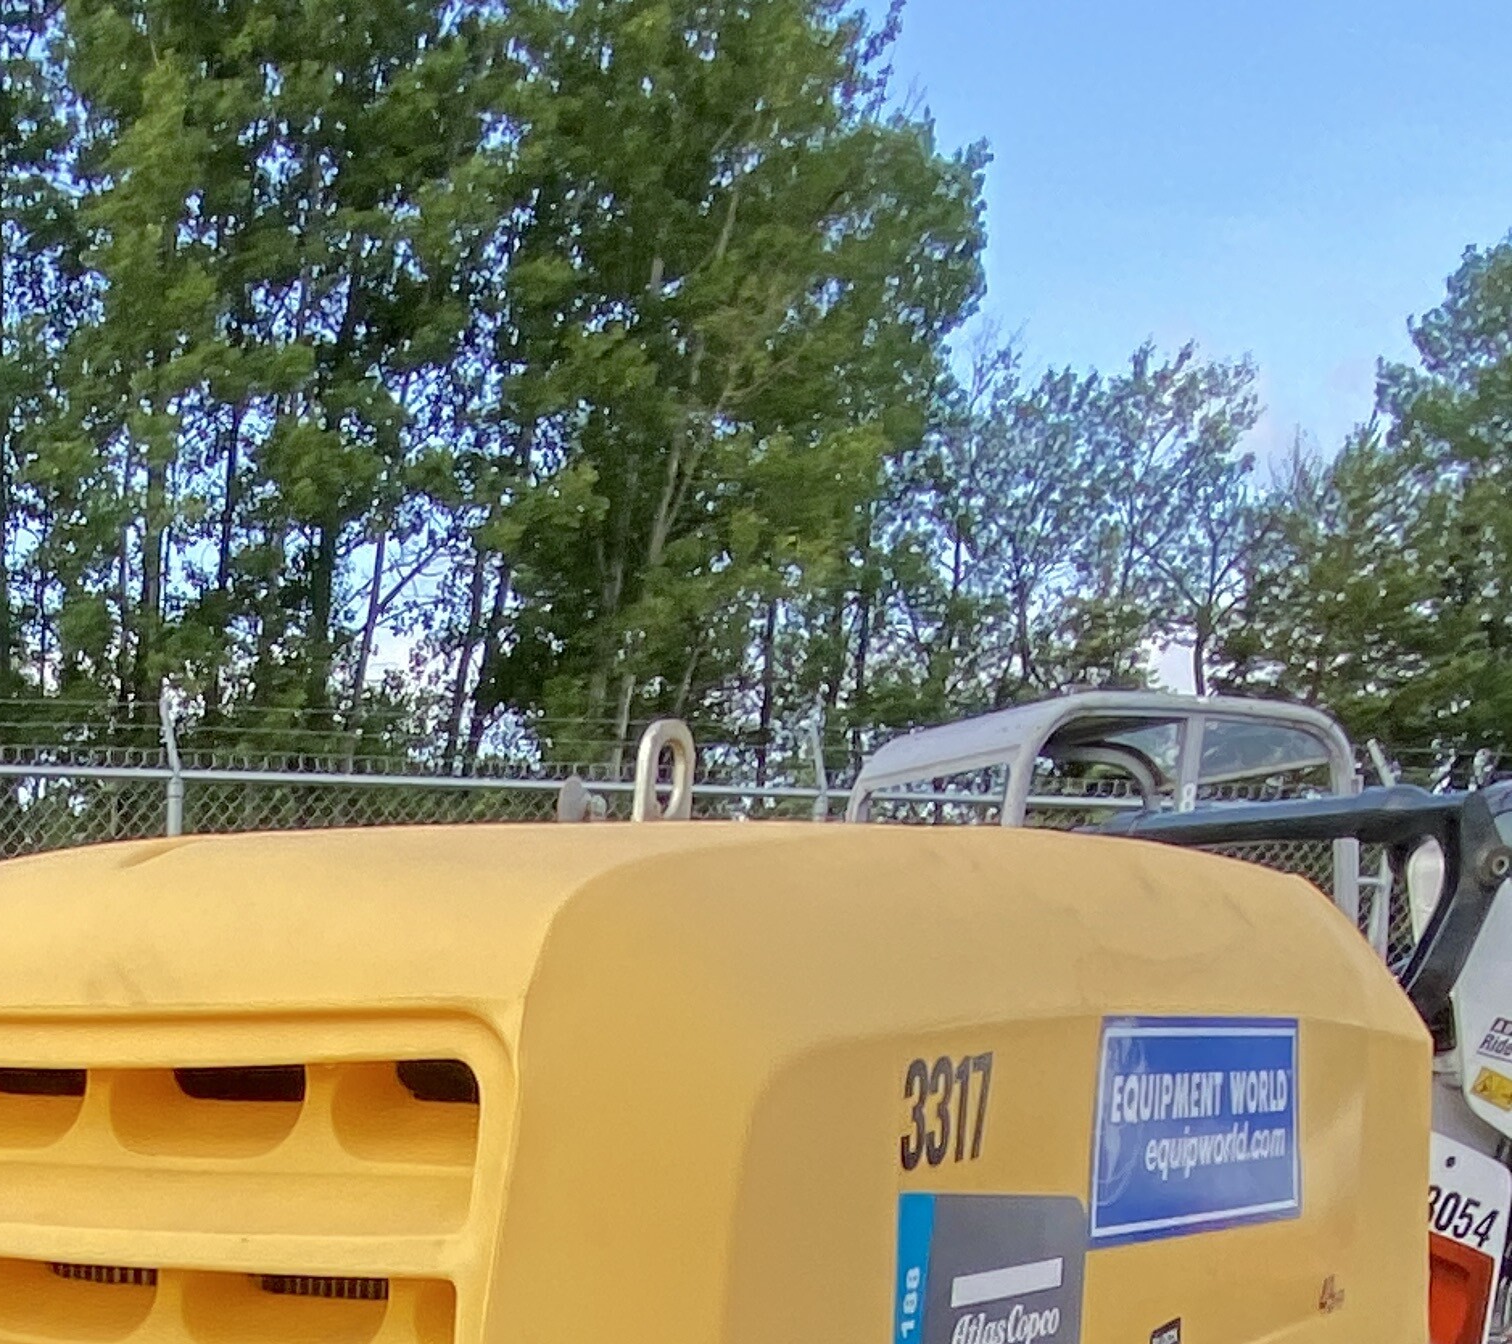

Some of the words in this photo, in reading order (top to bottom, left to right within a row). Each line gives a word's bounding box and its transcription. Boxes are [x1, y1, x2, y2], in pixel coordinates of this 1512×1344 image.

[901, 1051, 994, 1172] 3317
[1110, 1072, 1224, 1124] EQUIPMENT
[1229, 1069, 1288, 1115] WORLD
[1144, 1120, 1286, 1181] equipworld.com
[901, 1266, 921, 1339] 188
